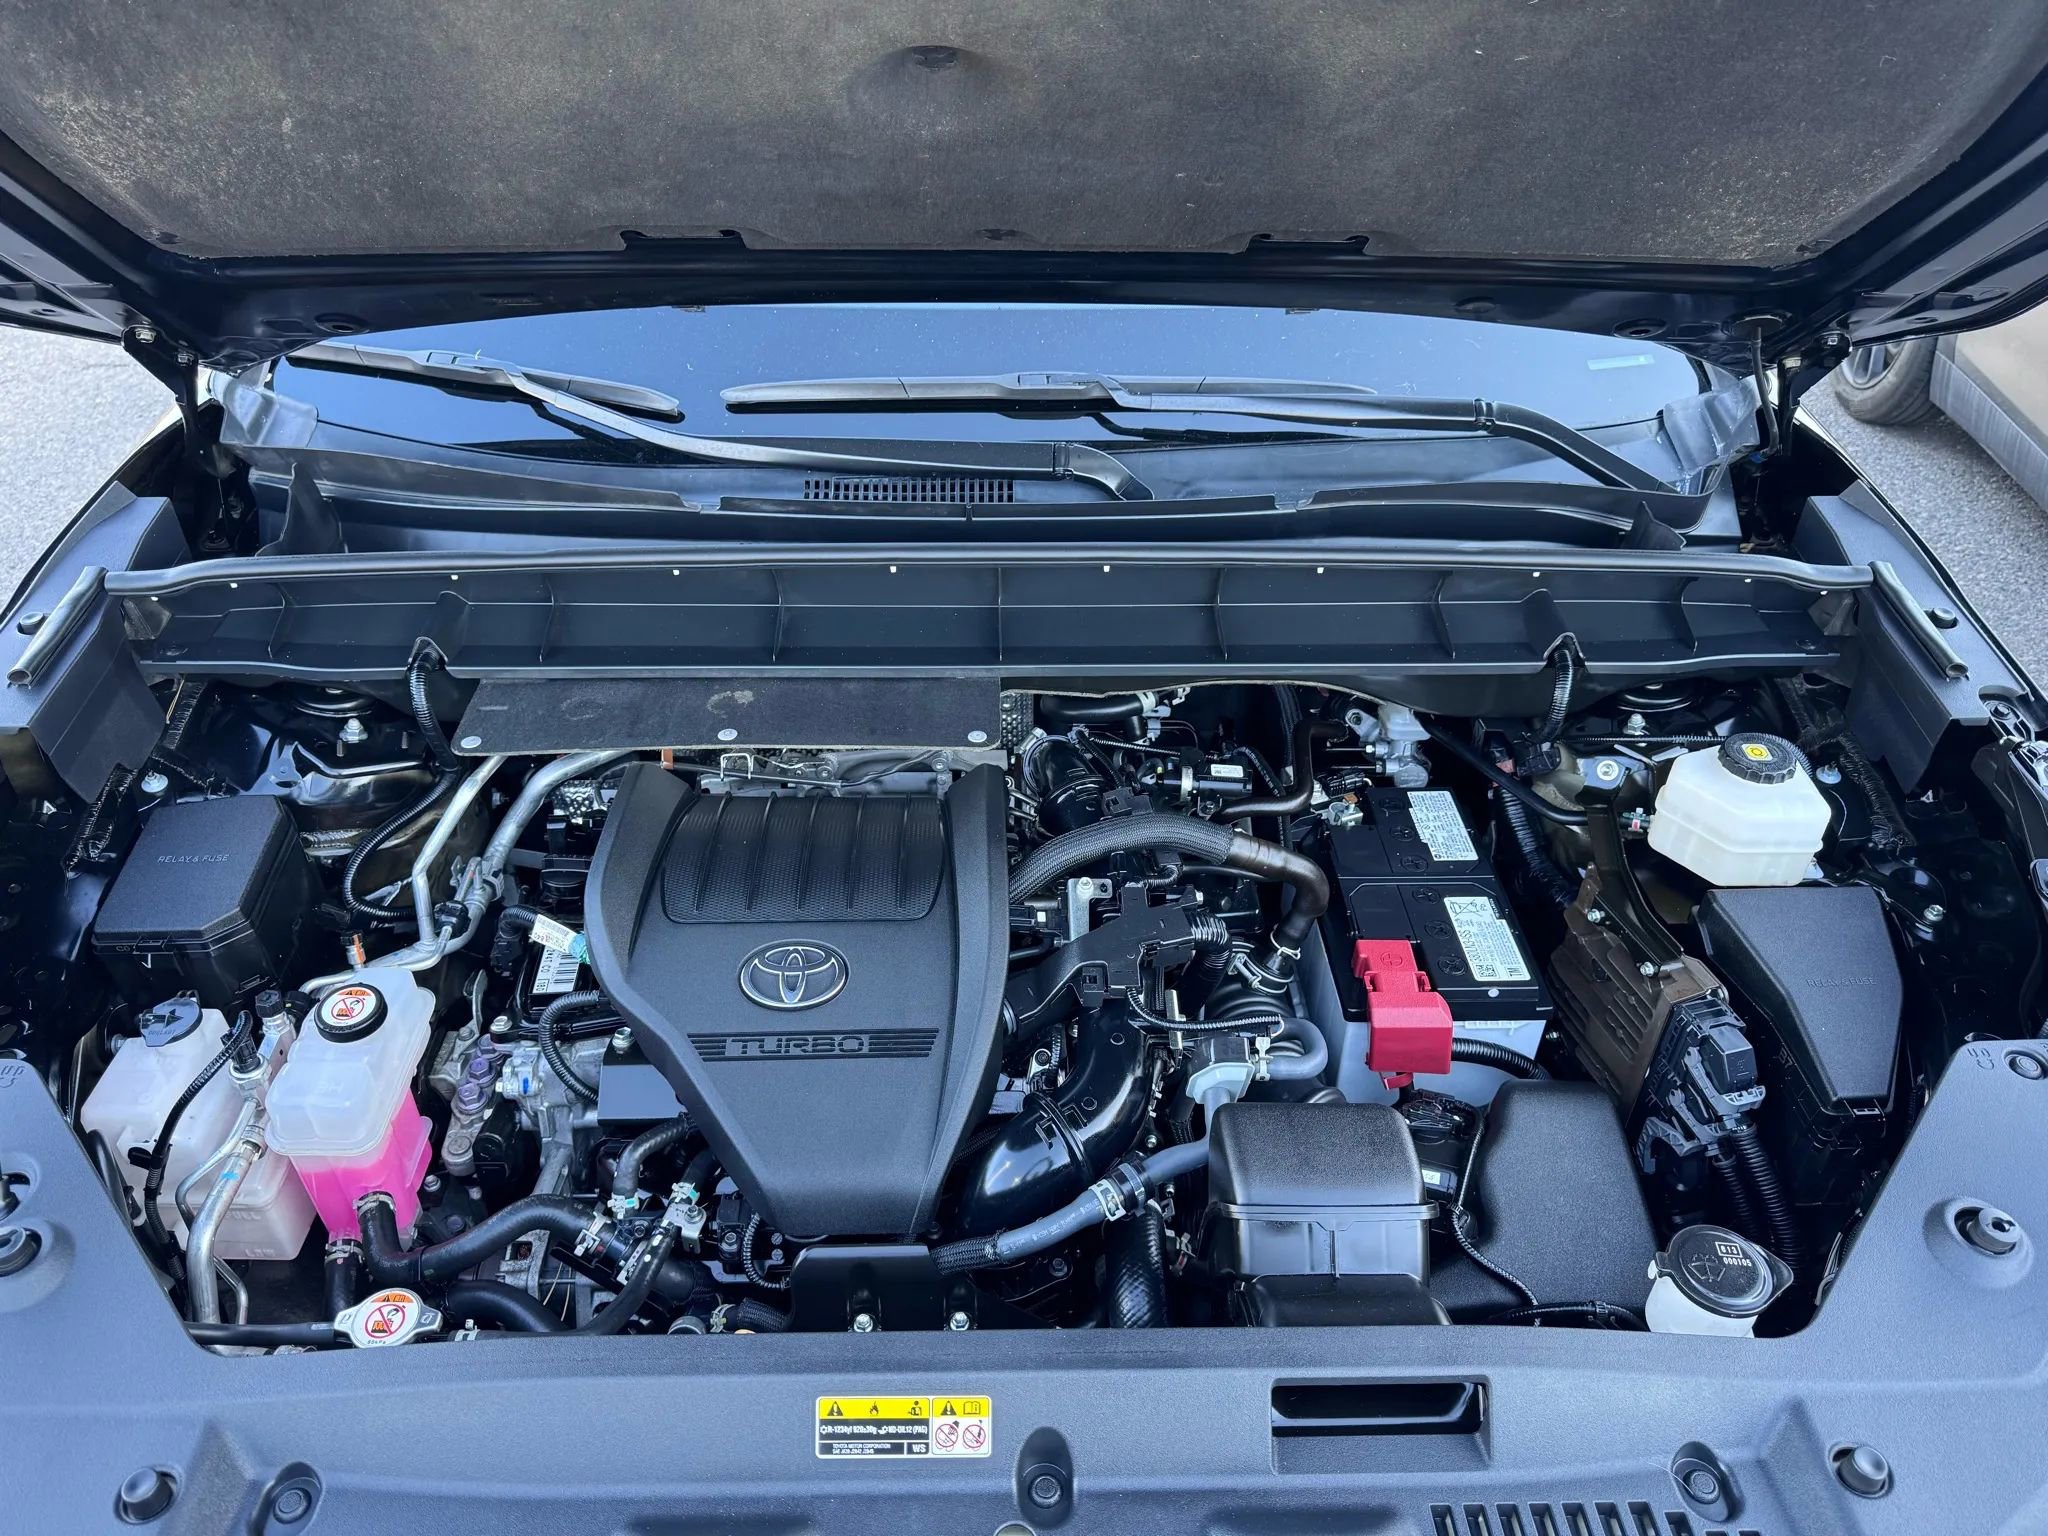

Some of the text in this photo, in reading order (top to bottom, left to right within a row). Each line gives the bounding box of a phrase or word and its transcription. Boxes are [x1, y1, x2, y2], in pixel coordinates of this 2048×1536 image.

[157, 855, 192, 863] RELAY
[201, 854, 230, 862] FUSE
[731, 1035, 865, 1055] TURBO
[912, 1444, 926, 1452] WS
